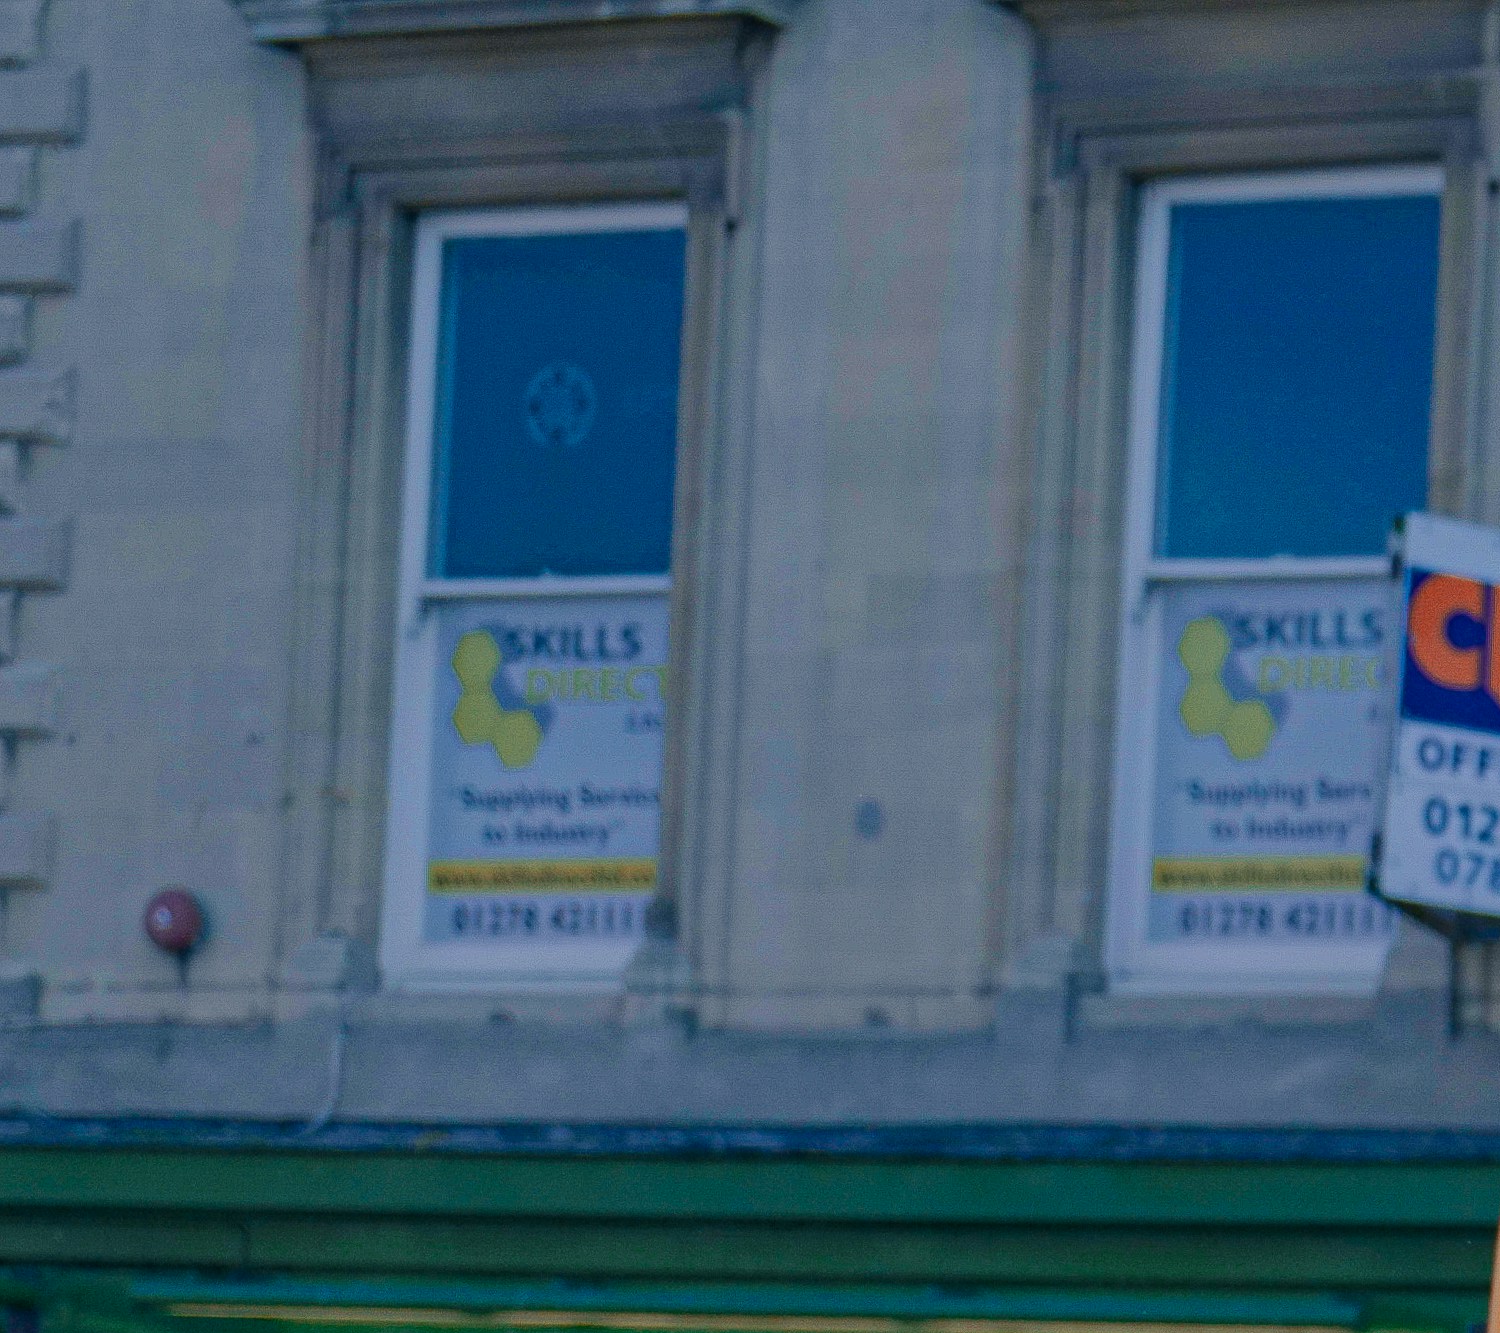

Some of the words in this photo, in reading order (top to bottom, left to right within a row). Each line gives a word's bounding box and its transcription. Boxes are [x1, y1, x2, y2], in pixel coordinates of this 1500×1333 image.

[502, 622, 642, 664] SKILLS
[1235, 609, 1385, 648] SKILLS
[1257, 655, 1386, 694] DIREC
[549, 901, 640, 935] 42111
